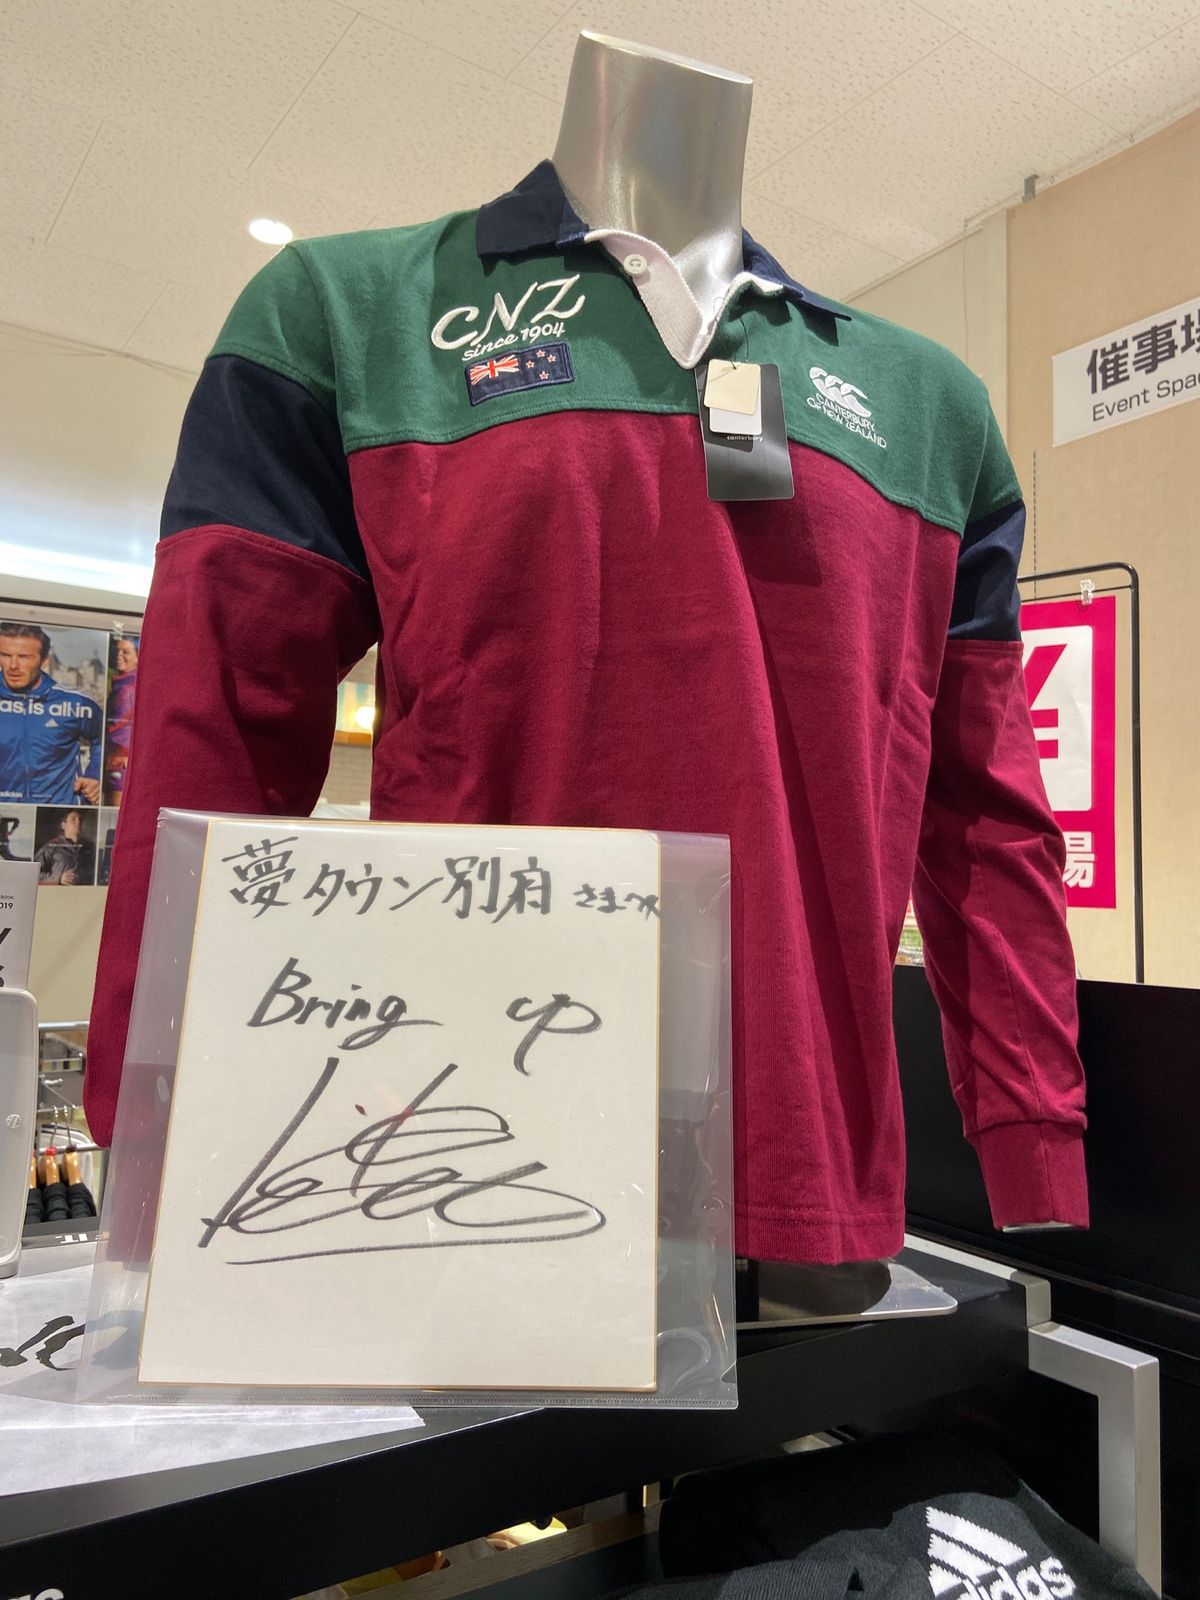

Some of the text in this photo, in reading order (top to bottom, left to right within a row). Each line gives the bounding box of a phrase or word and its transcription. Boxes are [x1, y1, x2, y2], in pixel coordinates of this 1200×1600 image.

[431, 273, 586, 350] CNZ
[520, 321, 565, 343] 1904
[815, 392, 876, 433] CANTERBURY
[1092, 371, 1200, 422] Event Spa
[806, 396, 888, 449] OF NEW ZEALAND
[28, 698, 45, 715] is
[75, 702, 93, 719] in
[246, 957, 444, 1051] Bring
